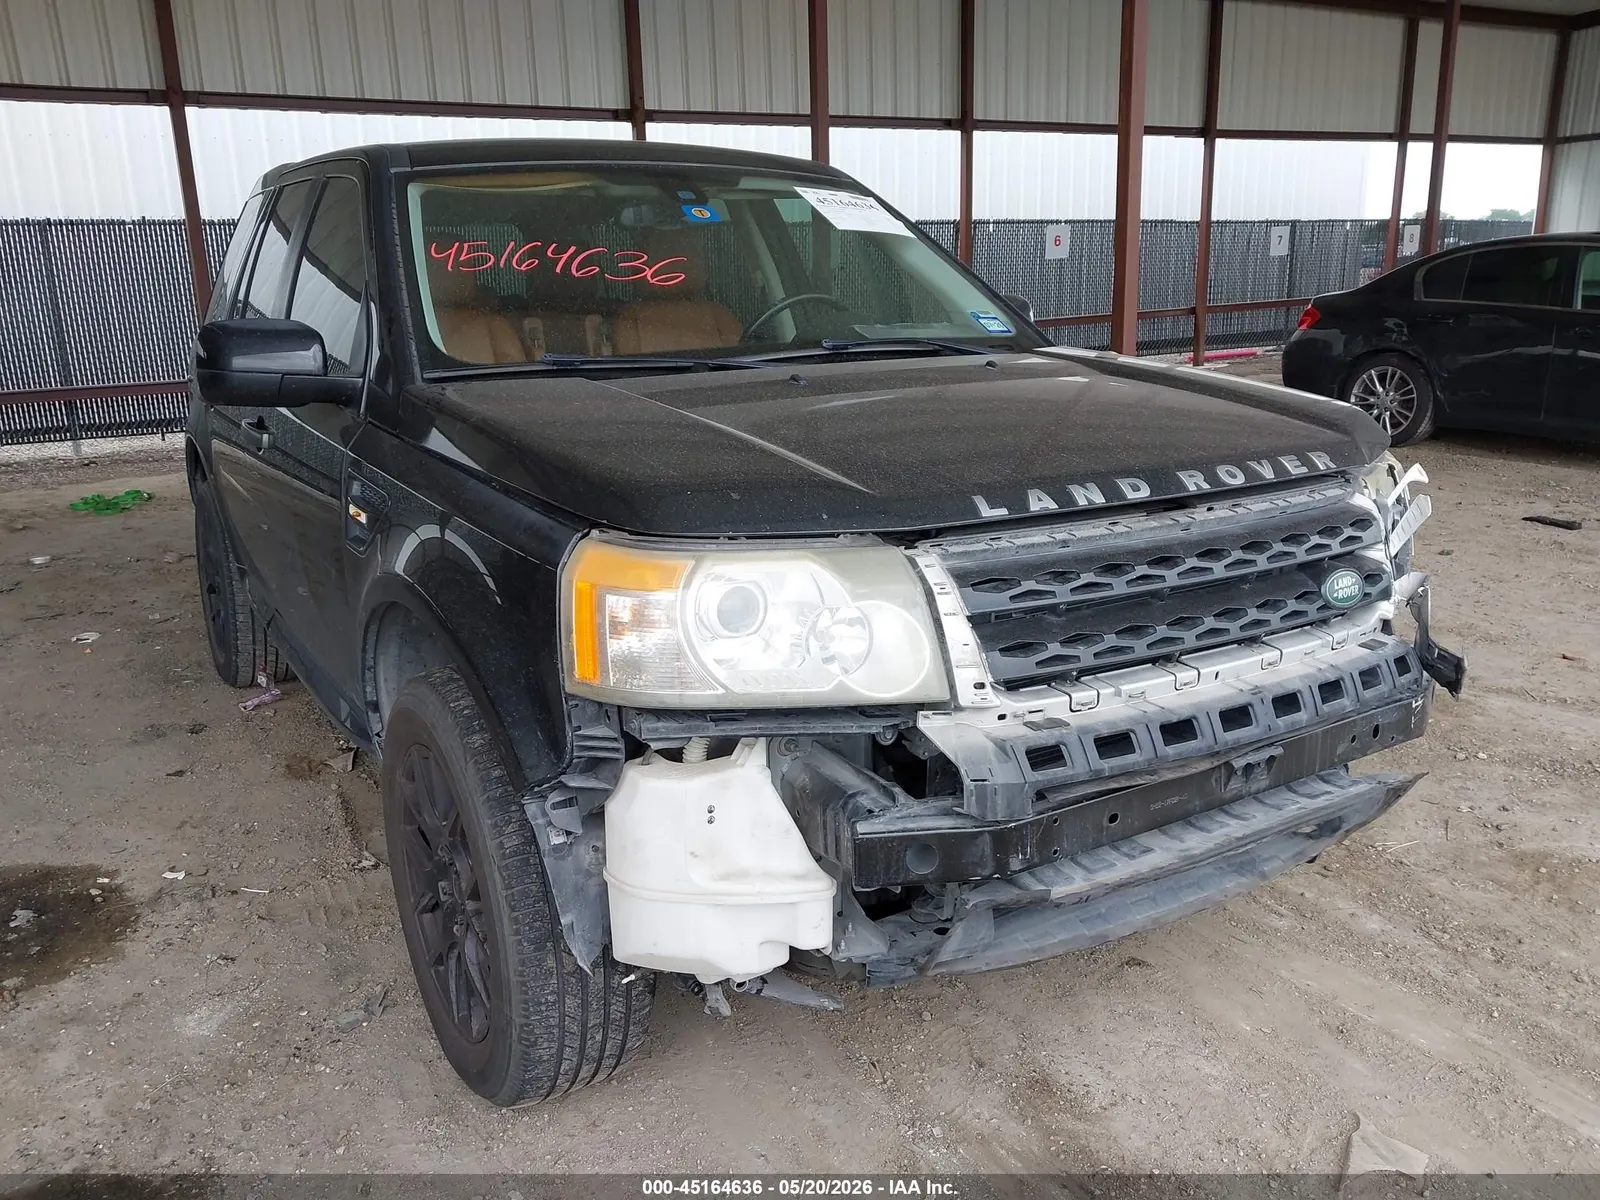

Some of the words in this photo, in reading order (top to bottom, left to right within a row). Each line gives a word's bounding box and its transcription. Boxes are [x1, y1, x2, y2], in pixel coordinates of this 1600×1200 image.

[1054, 235, 1061, 246] 6
[1277, 235, 1283, 246] 7
[1409, 233, 1415, 243] 8
[430, 240, 688, 286] 45164636
[971, 477, 1151, 518] LAND
[1176, 450, 1339, 492] ROVER
[1334, 576, 1352, 590] LAND
[1338, 584, 1359, 599] ROVER
